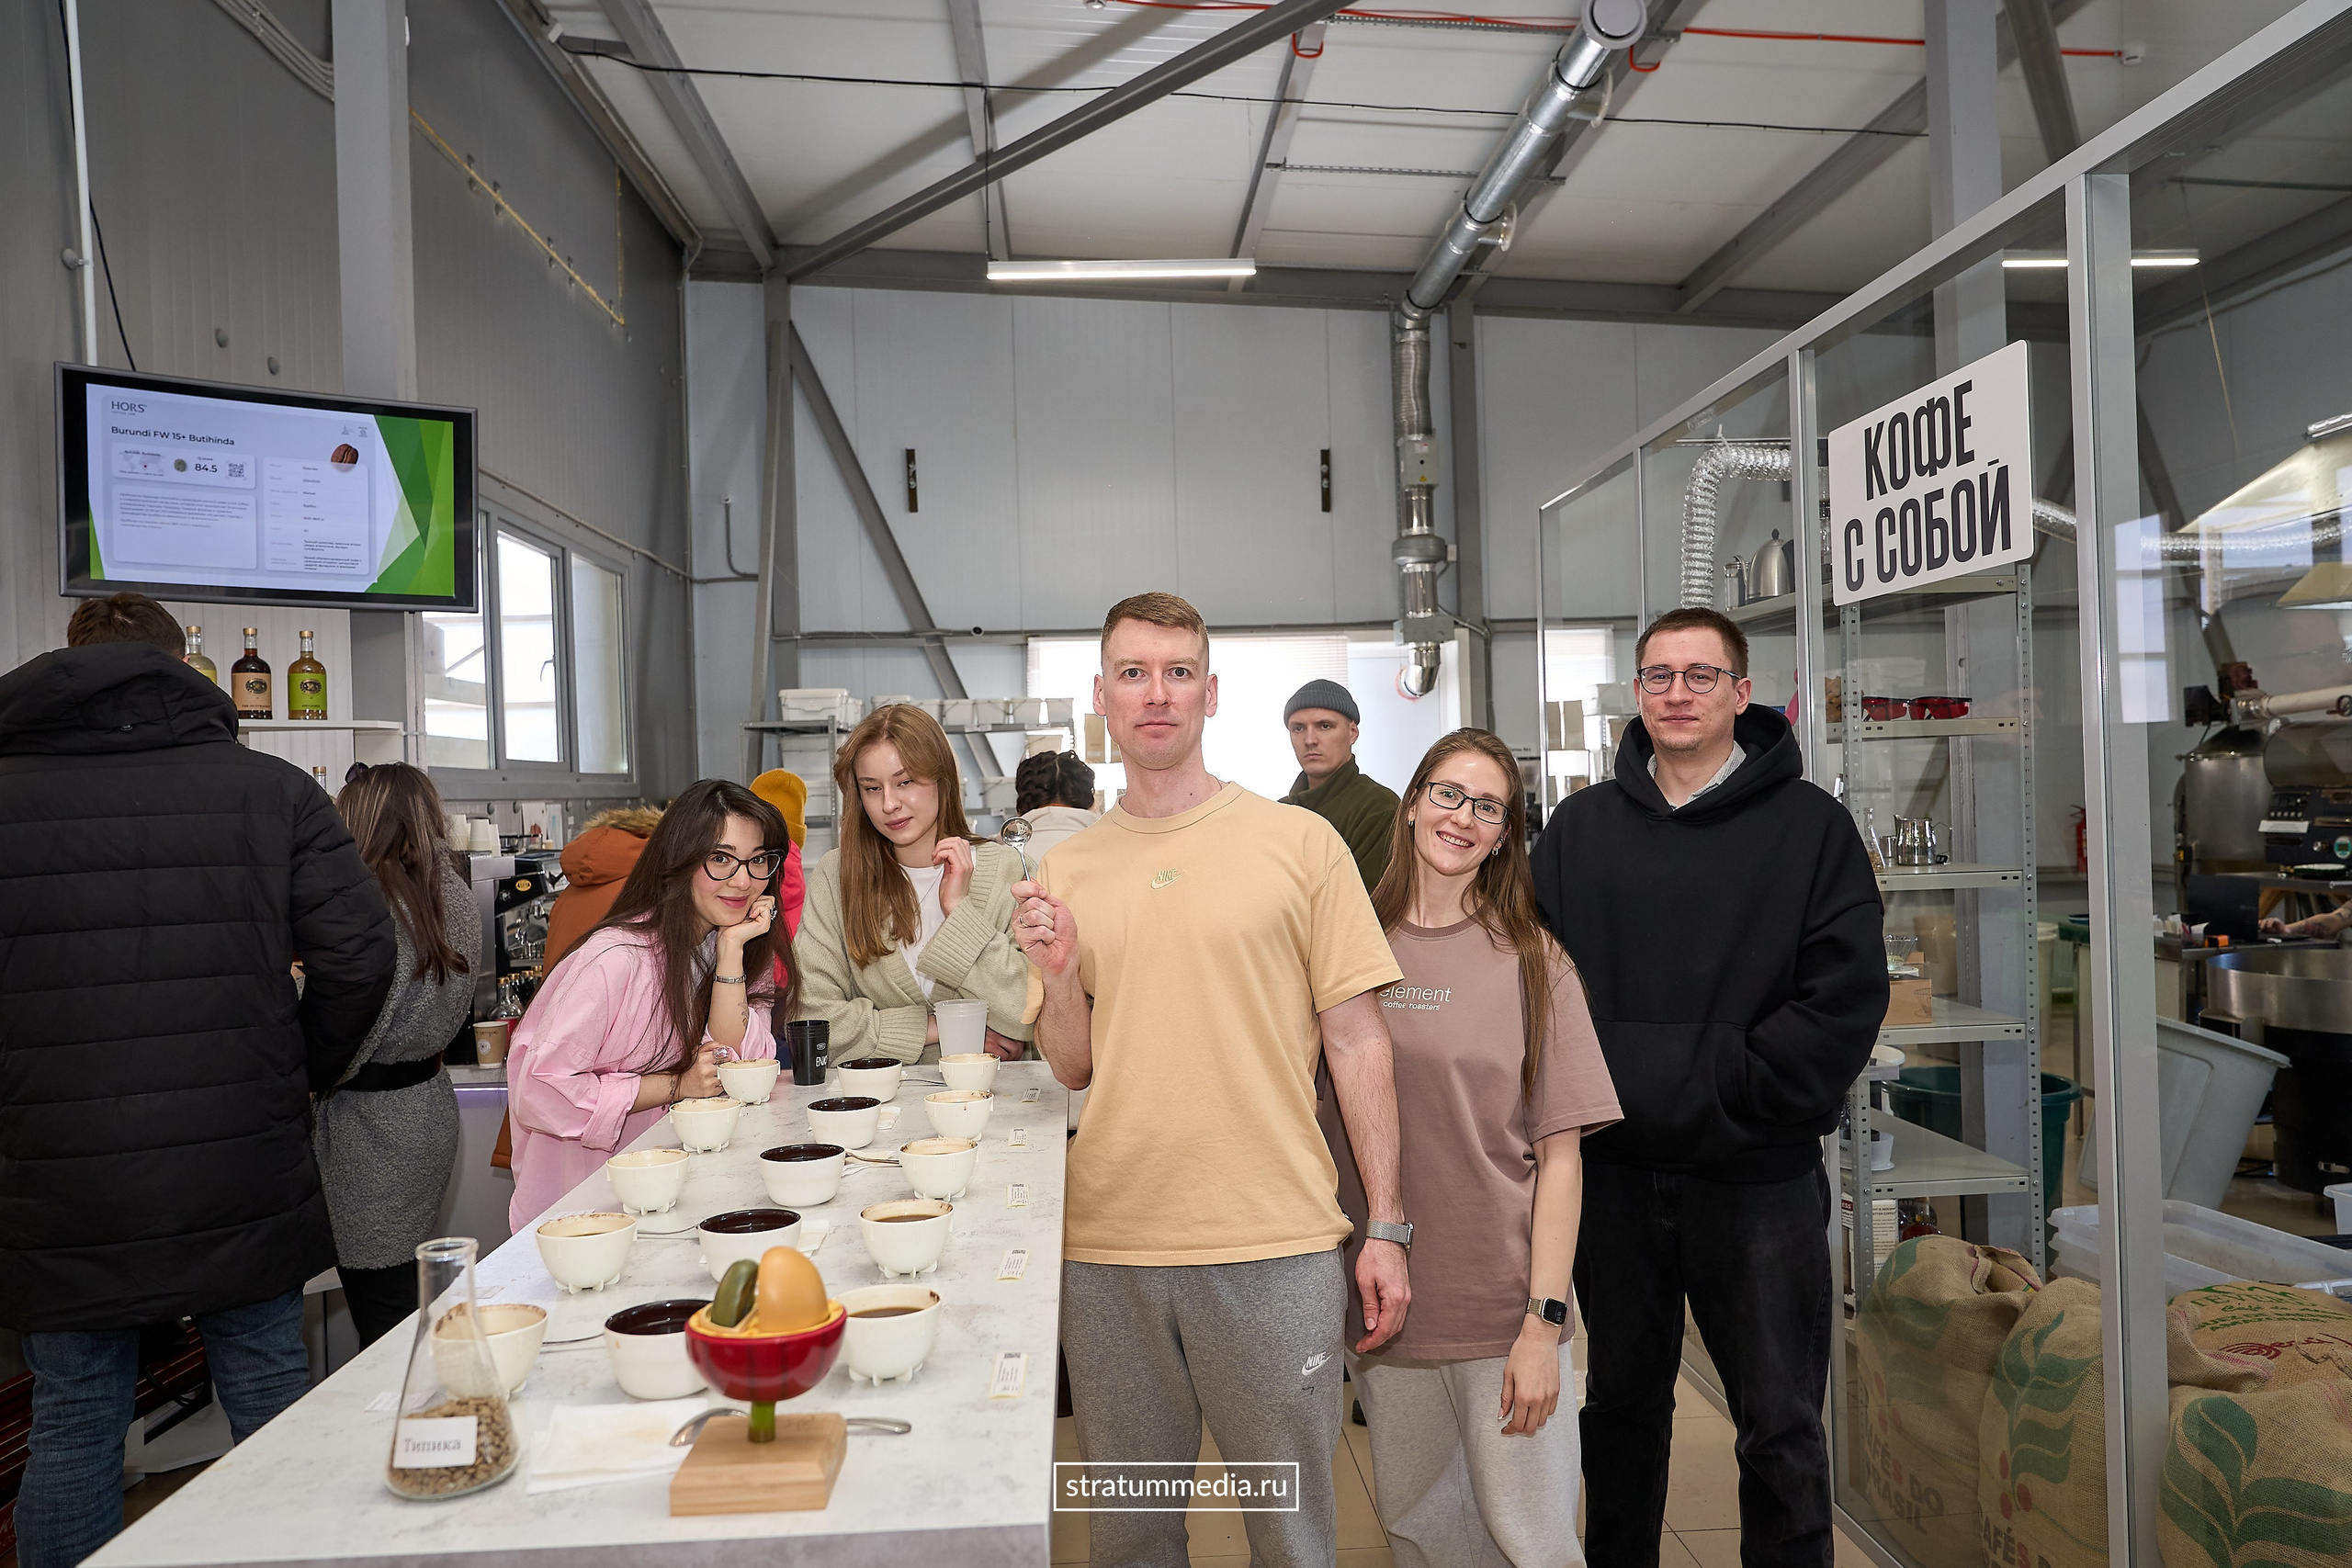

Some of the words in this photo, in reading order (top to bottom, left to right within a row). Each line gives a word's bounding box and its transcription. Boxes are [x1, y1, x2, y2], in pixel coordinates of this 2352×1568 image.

[111, 400, 145, 413] HORS
[111, 426, 151, 438] Burundi
[153, 431, 170, 439] FW
[172, 433, 186, 441] 15+
[189, 434, 235, 446] Butihinda
[1864, 379, 1975, 502] КОФЕ
[195, 463, 218, 473] 84.5
[1844, 518, 1864, 592] С
[1875, 458, 2012, 583] СОБОЙ
[1157, 869, 1177, 882] NIKE
[1383, 1000, 1407, 1009] coffee
[1408, 1002, 1441, 1011] roasters
[1306, 1351, 1326, 1368] NIKE
[404, 1438, 461, 1453] Типика
[1867, 1425, 1903, 1486] AFÉS
[1909, 1472, 1944, 1517] DO
[1983, 1517, 2031, 1568] AFÉS
